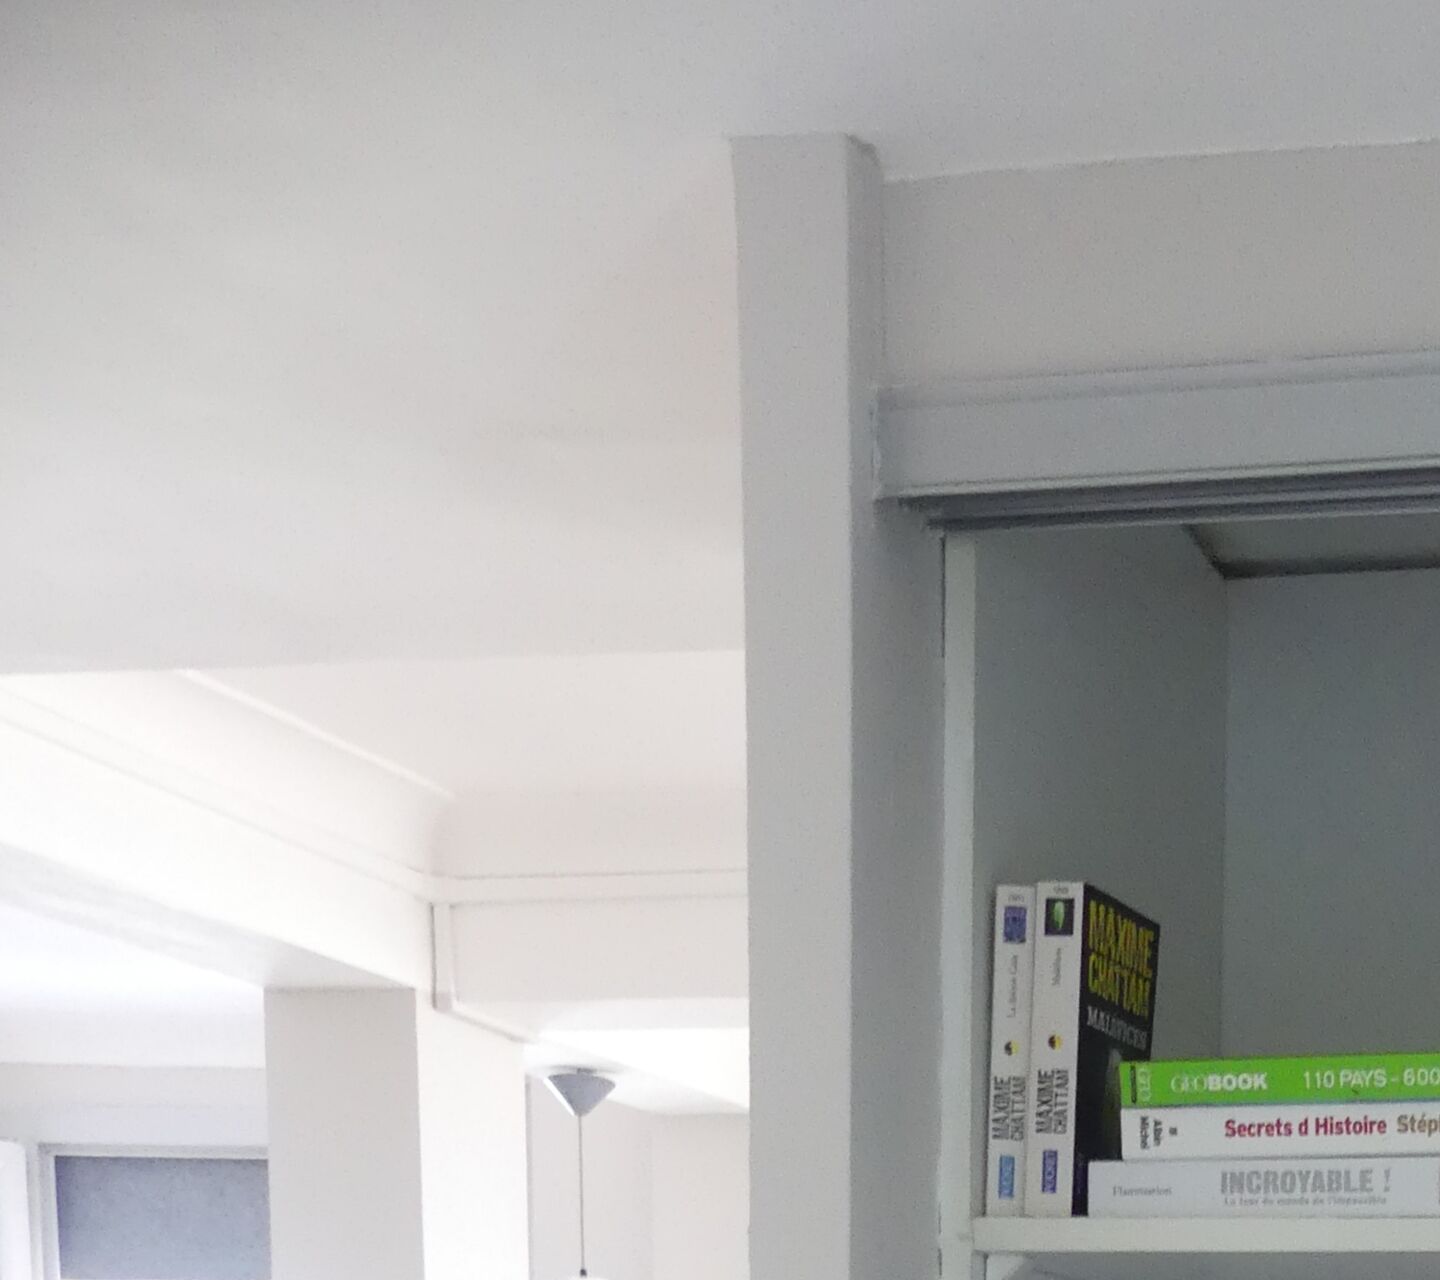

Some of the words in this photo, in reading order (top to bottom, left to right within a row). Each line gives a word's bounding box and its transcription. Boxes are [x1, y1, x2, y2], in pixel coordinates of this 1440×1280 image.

[1088, 898, 1154, 978] MAXIME
[1088, 951, 1152, 1020] CHATTAM
[992, 1075, 1011, 1140] MAXIME
[1010, 1075, 1026, 1142] CHATTAM
[1035, 1069, 1053, 1134] MAXIME
[1053, 1069, 1069, 1135] CHATTAM
[1170, 1071, 1268, 1094] GEOBOOK
[1303, 1071, 1335, 1090] 110
[1339, 1067, 1387, 1089] PAYS
[1224, 1118, 1293, 1138] Secrets
[1314, 1114, 1387, 1136] Histoire
[1221, 1168, 1374, 1195] INCROYABLE
